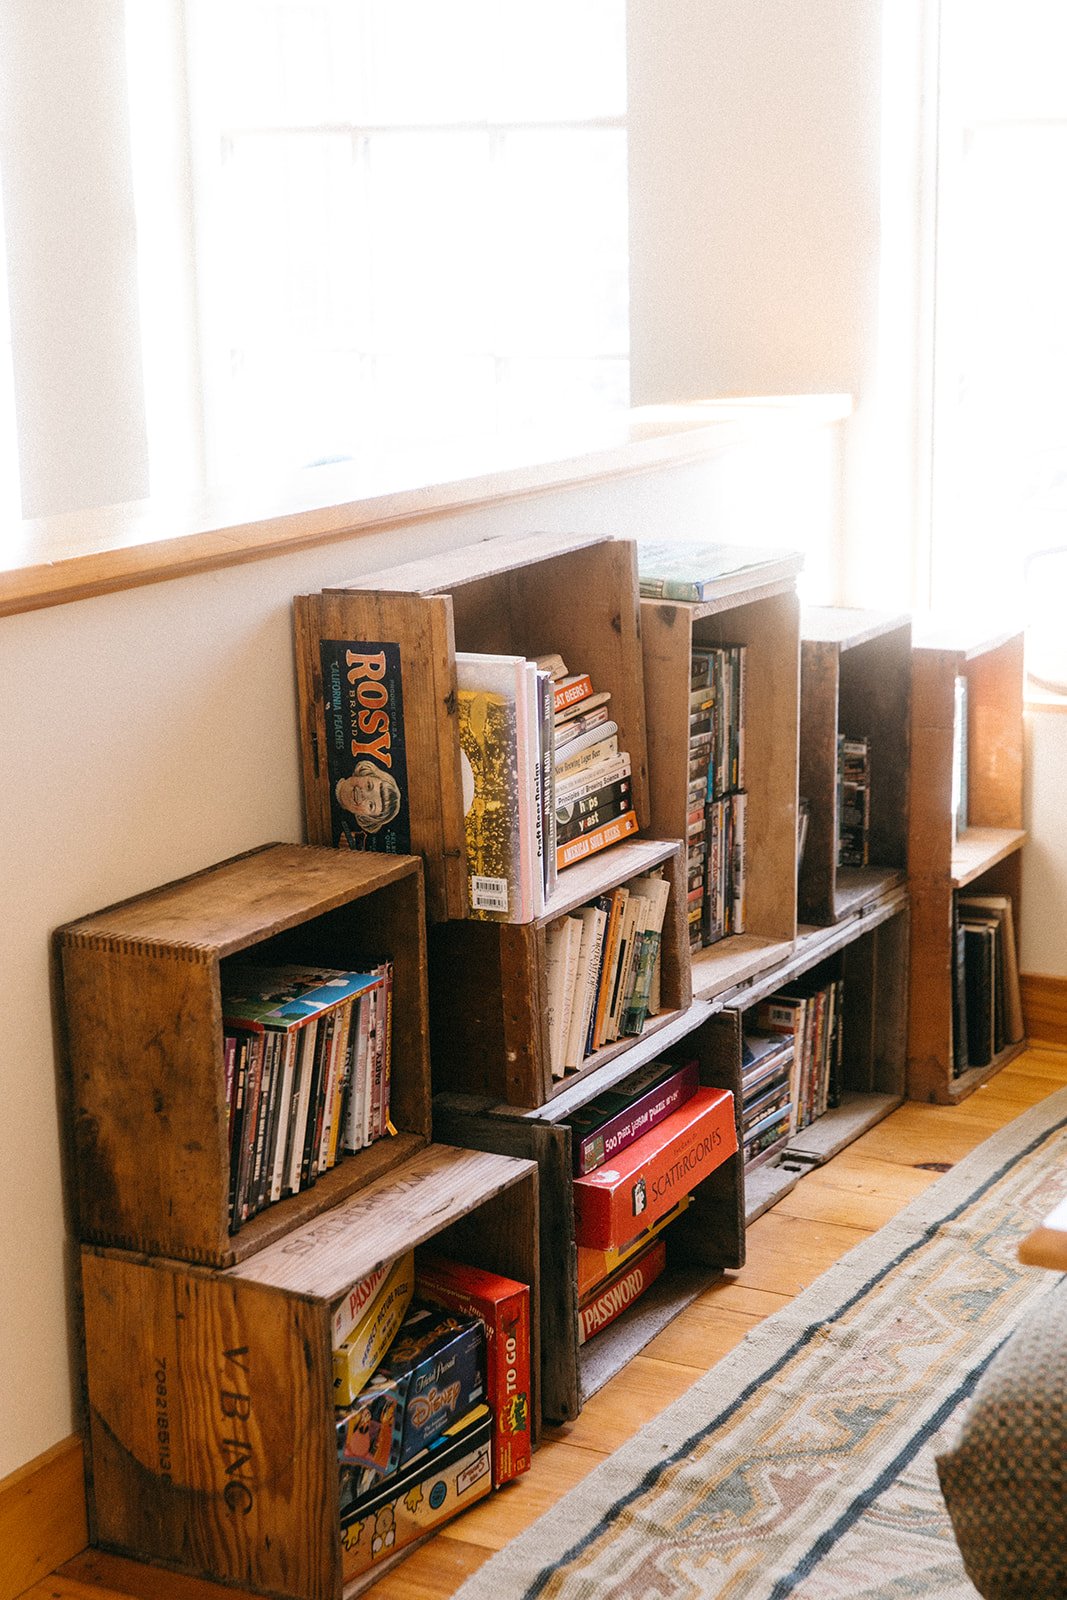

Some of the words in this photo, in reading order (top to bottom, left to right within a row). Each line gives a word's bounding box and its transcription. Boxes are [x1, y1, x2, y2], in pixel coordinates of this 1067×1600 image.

[329, 660, 342, 711] CALIFORNIA
[554, 690, 566, 709] EAT
[565, 685, 585, 705] BEERS
[345, 649, 392, 769] ROSY
[349, 690, 358, 737] BRAND
[334, 713, 345, 750] PEACHES
[591, 749, 601, 761] Beer
[544, 775, 550, 787] TO
[558, 790, 580, 805] Principles
[585, 780, 603, 795] Brewing
[602, 772, 620, 787] Science
[579, 796, 599, 814] hops
[578, 811, 599, 831] yeast
[605, 1136, 617, 1152] 500
[652, 1127, 722, 1202] SCATTERGORIES
[350, 1264, 389, 1321] PASSW
[376, 1292, 394, 1323] PICTURE
[586, 1269, 644, 1334] PASSWORD
[505, 1336, 517, 1366] GO
[506, 1368, 517, 1395] TO
